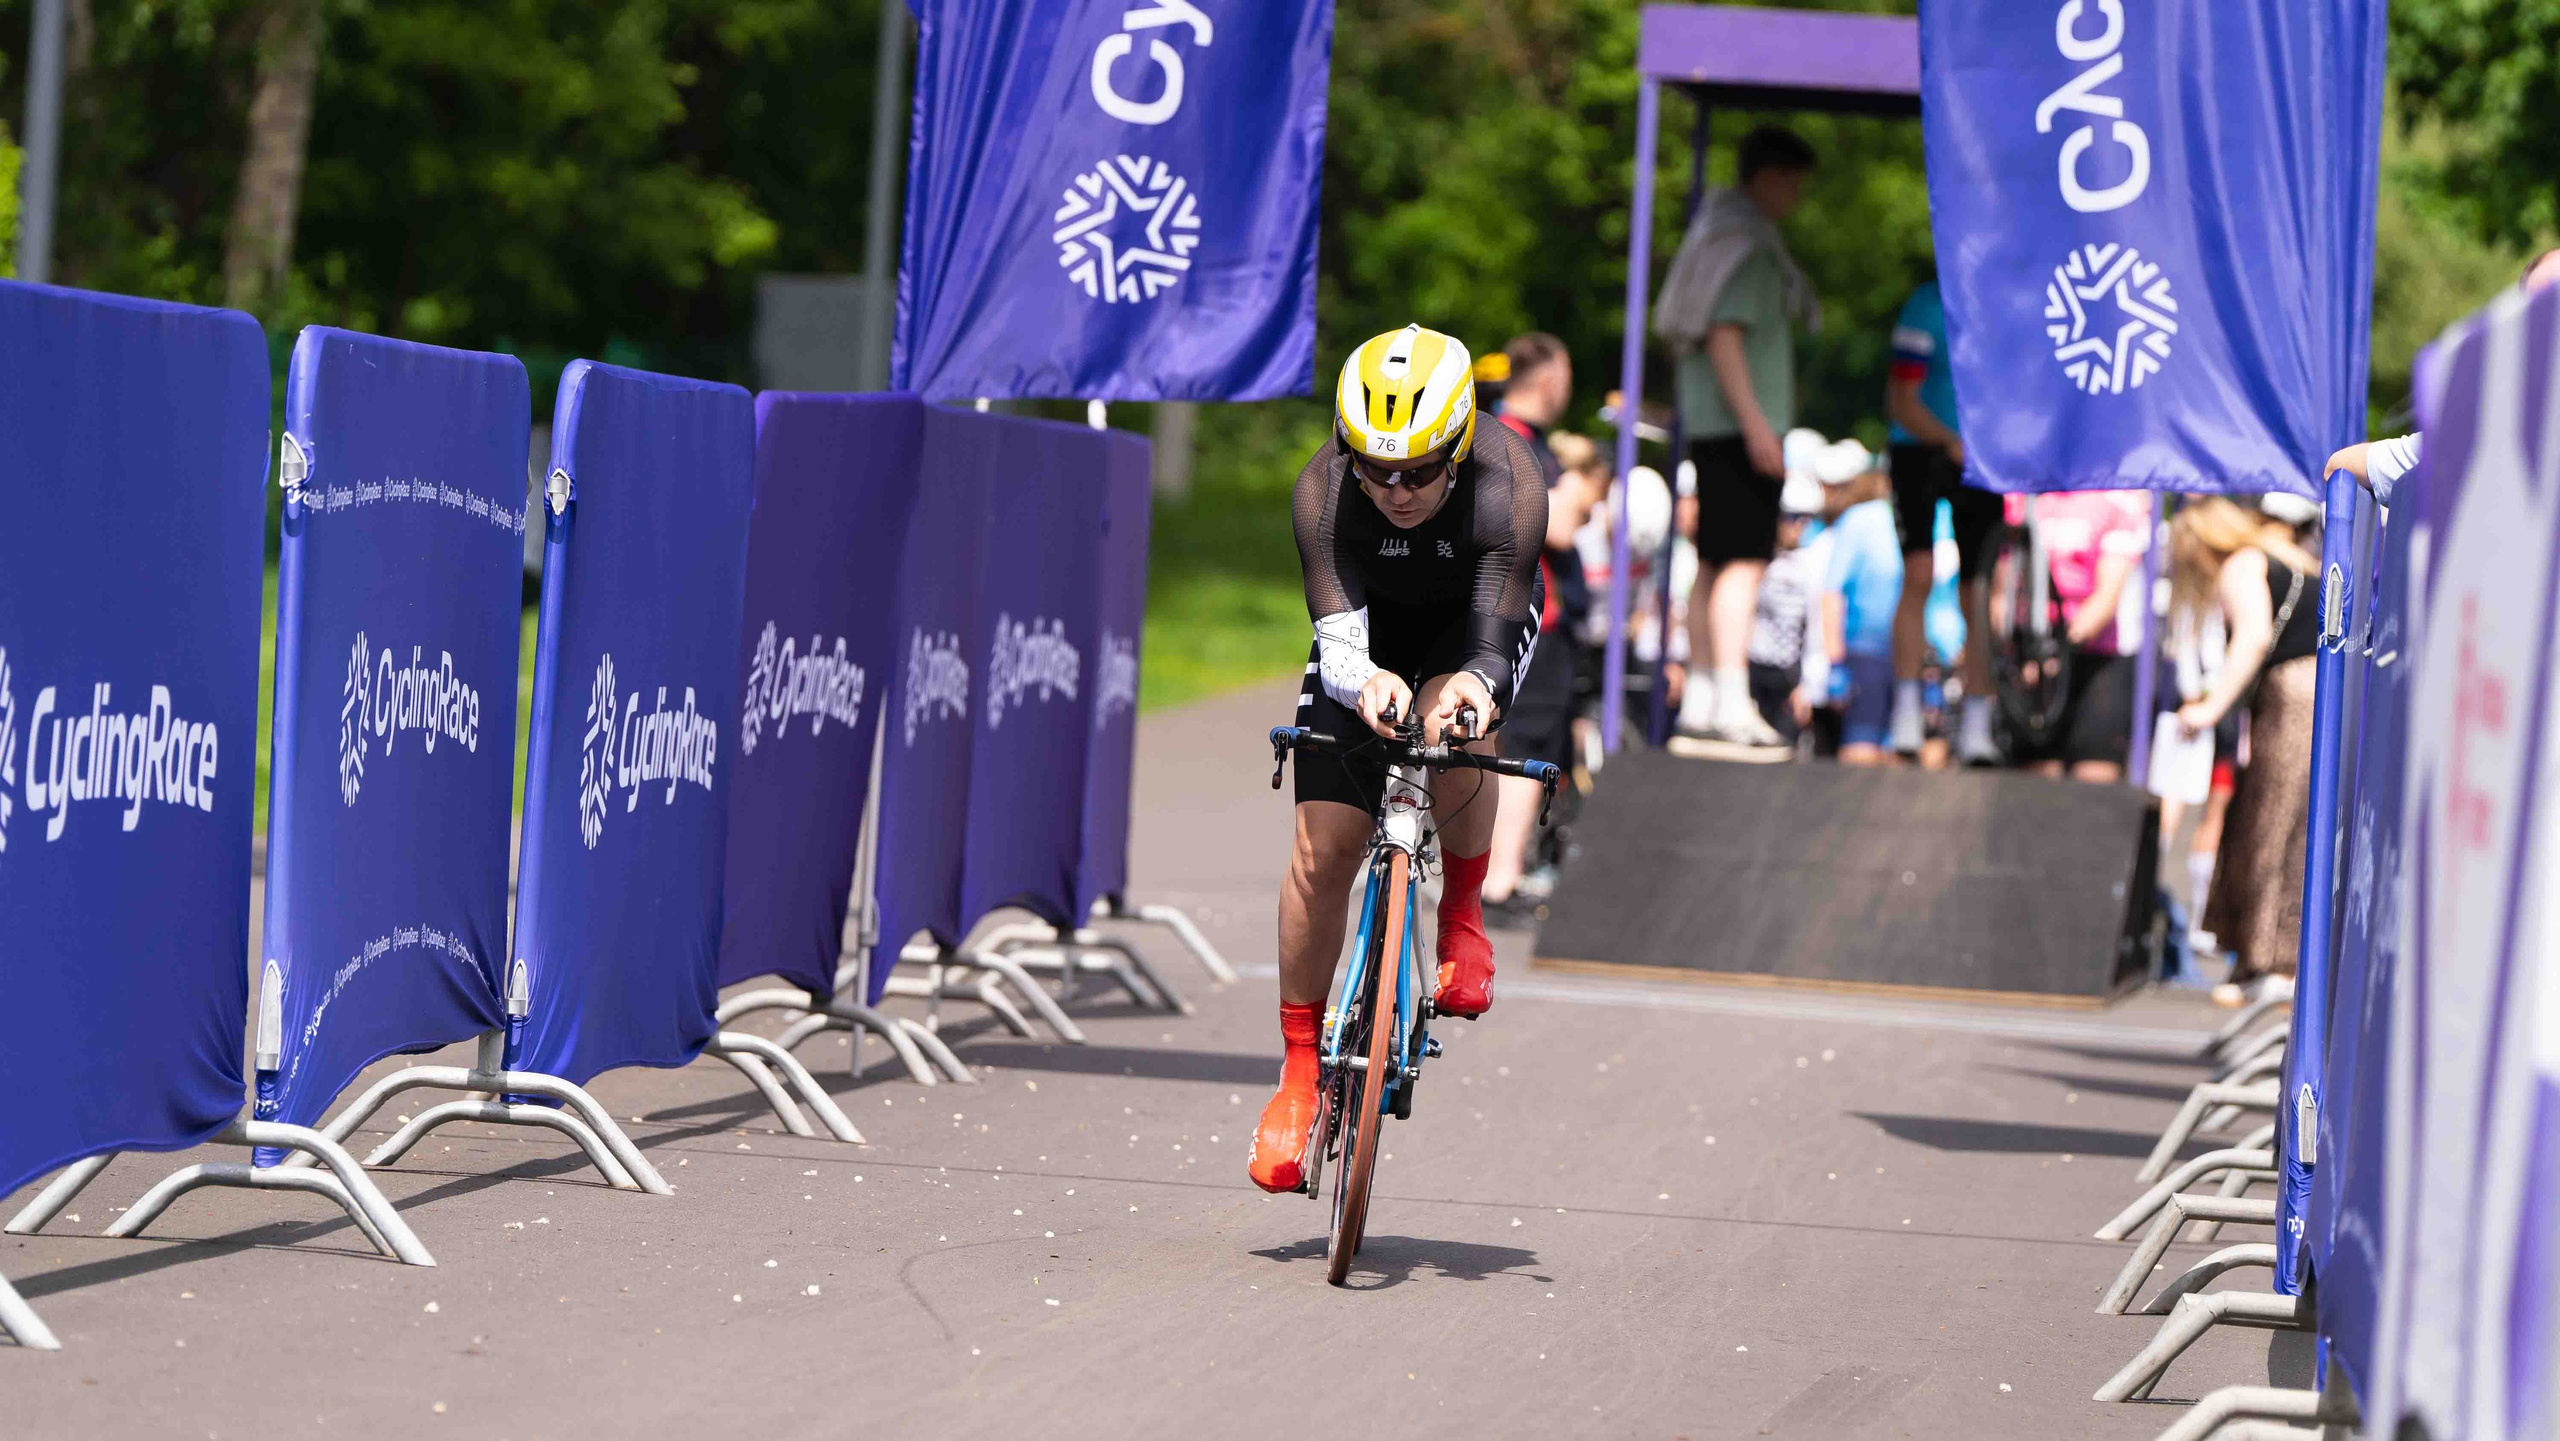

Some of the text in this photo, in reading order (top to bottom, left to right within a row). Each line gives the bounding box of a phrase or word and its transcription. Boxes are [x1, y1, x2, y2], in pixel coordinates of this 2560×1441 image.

[1377, 436, 1396, 452] 76
[375, 645, 479, 757] CyclingRace
[772, 633, 865, 739] CyclingRace
[25, 682, 218, 842] CyclingRace
[619, 686, 717, 813] CyclingRace
